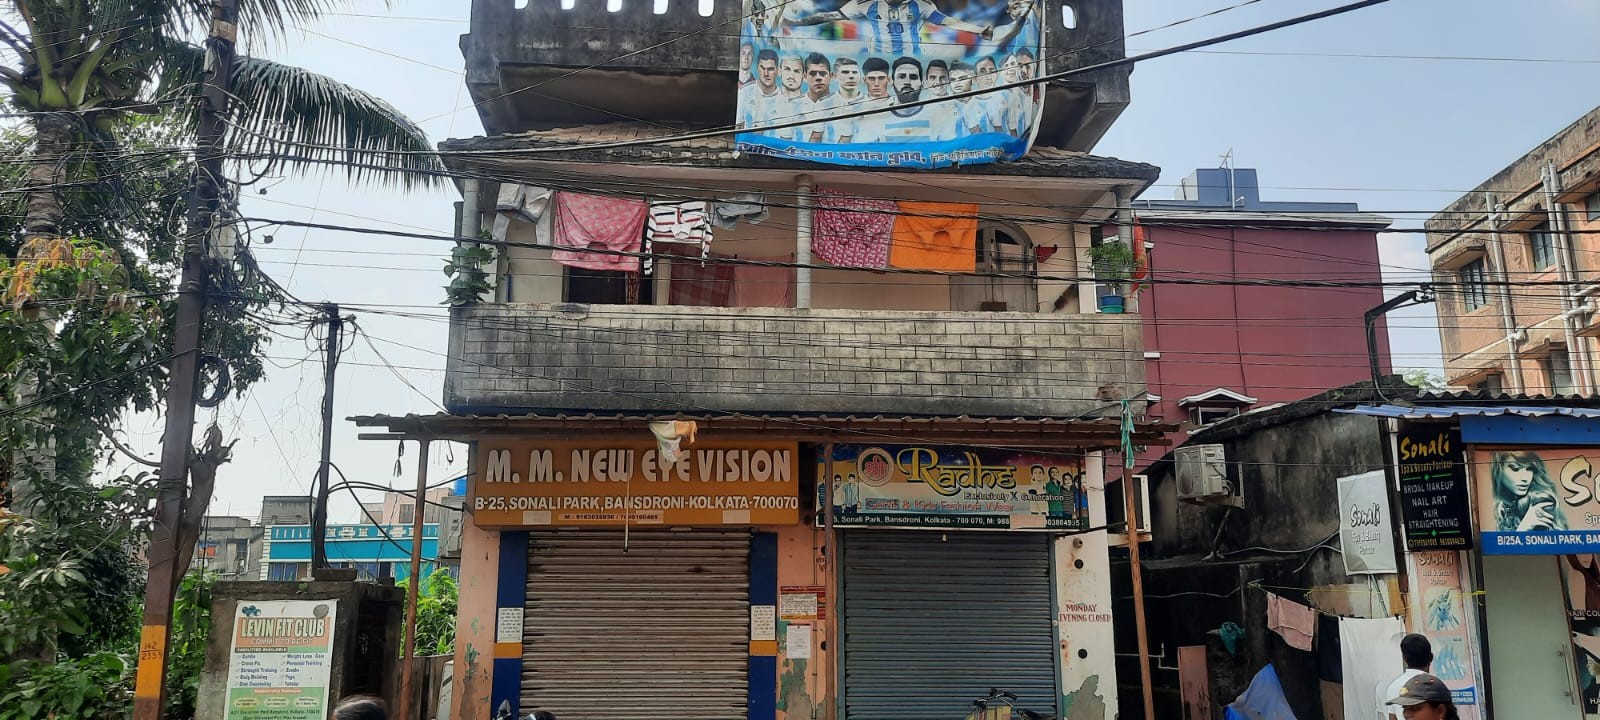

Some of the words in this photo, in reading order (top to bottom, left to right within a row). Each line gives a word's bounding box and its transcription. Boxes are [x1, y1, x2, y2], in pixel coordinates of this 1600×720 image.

[1400, 433, 1449, 460] Sonali
[486, 449, 520, 484] M.
[528, 449, 564, 484] M.
[571, 449, 634, 482] NEW
[641, 449, 690, 482] EYE
[697, 449, 791, 483] VISION
[896, 447, 1017, 497] Radhe
[1403, 484, 1425, 494] BRIDAL
[1426, 480, 1454, 492] MAKEUP
[1412, 497, 1429, 507] NAIL
[1431, 495, 1447, 505] ART
[1423, 509, 1439, 518] HAIR
[1408, 518, 1459, 529] STRAIGHTENING
[1497, 535, 1523, 546] B/25A,
[1525, 535, 1557, 545] SONALI
[1559, 534, 1584, 546] PARK,
[1066, 604, 1097, 612] MONDAY
[1060, 613, 1087, 622] EVENING
[1088, 613, 1111, 622] CLOSED
[241, 618, 275, 637] LEVIN
[276, 618, 294, 637] FIT
[294, 618, 325, 637] CLUB
